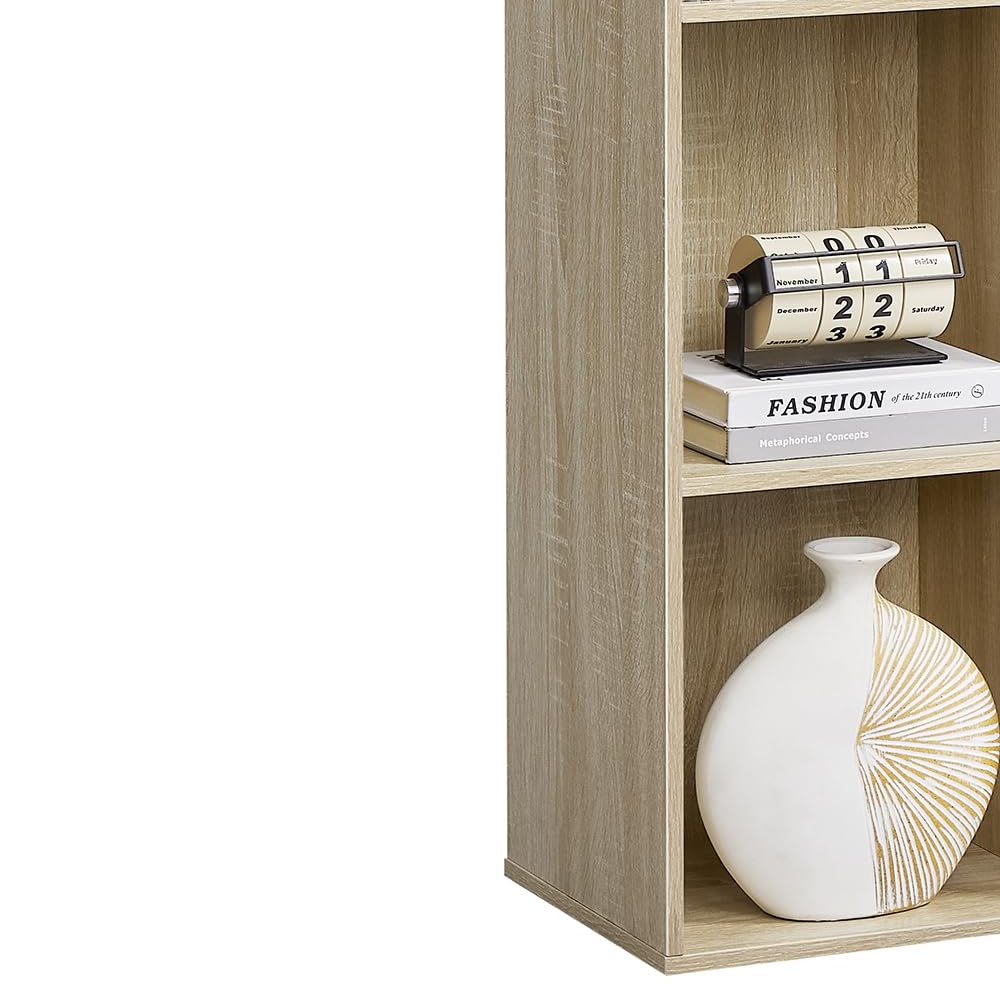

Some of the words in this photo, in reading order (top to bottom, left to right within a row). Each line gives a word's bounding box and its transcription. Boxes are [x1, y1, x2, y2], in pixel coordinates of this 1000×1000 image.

[835, 261, 850, 283] 1
[875, 259, 890, 280] 1
[776, 277, 819, 287] November
[777, 306, 818, 314] December
[833, 295, 854, 320] 2
[873, 293, 893, 318] 2
[911, 304, 945, 314] Saturday
[766, 337, 809, 345] January
[825, 326, 847, 342] 3
[865, 324, 886, 339] 3
[766, 390, 886, 417] FASHION
[891, 393, 901, 404] of
[902, 393, 914, 401] the
[933, 389, 962, 399] century
[759, 433, 822, 448] Metaphorical
[825, 429, 869, 442] Concepts
